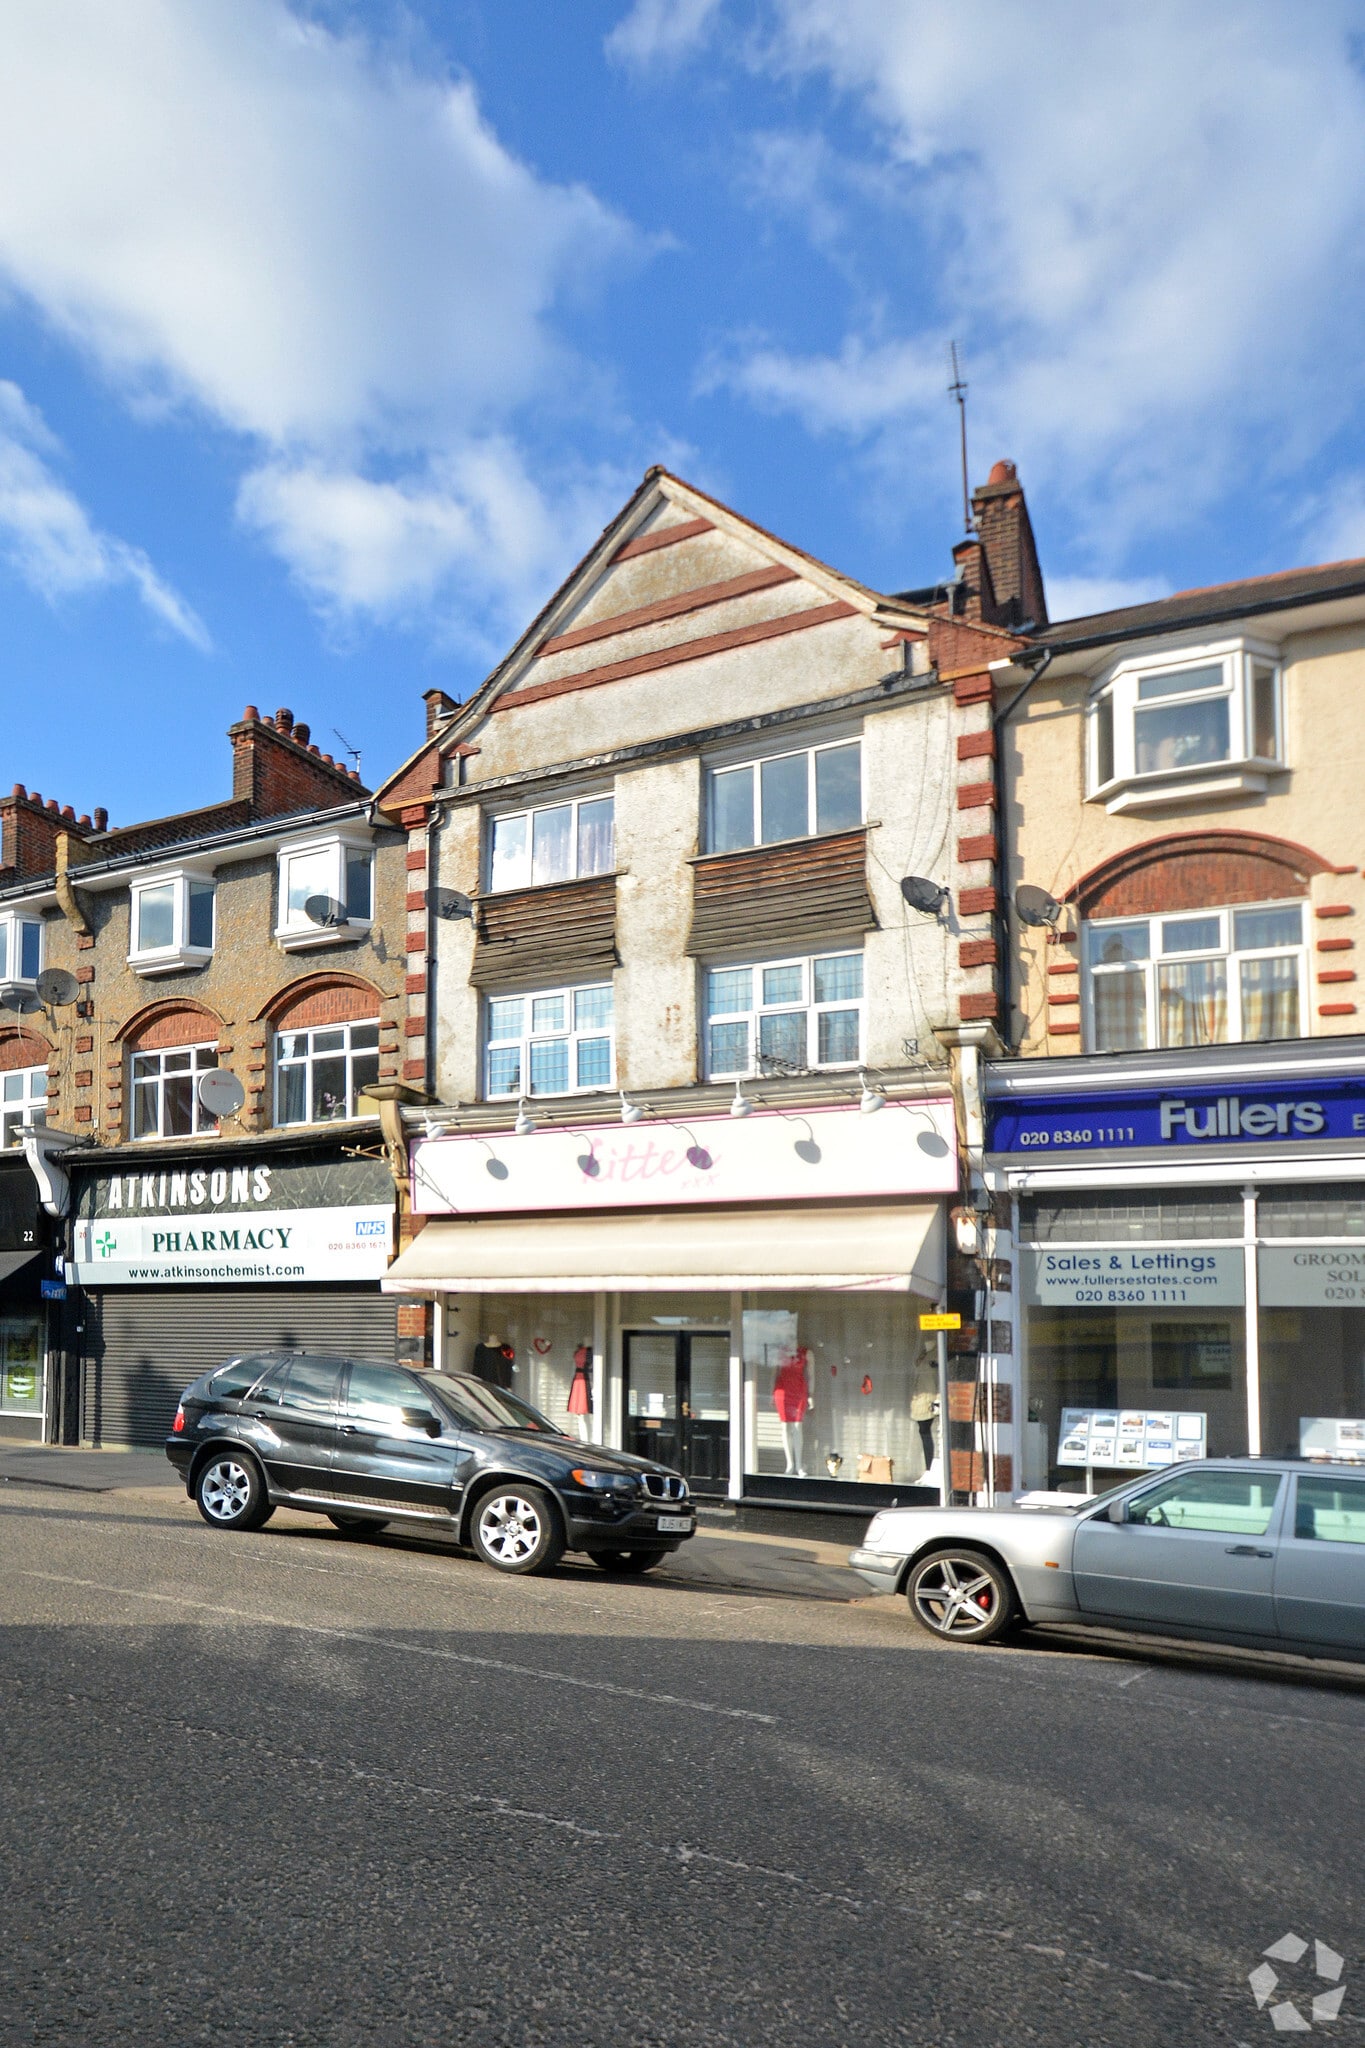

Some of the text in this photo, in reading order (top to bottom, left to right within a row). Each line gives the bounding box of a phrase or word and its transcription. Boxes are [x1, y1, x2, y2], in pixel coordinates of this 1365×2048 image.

[1159, 1097, 1326, 1139] Fullers
[1020, 1127, 1134, 1145] 020 8360 1111
[108, 1164, 272, 1209] ATKINSONS
[357, 1221, 385, 1235] NHS
[23, 1231, 34, 1242] 22
[152, 1227, 293, 1253] PHARMACY
[345, 1242, 366, 1250] 8360
[1046, 1253, 1217, 1272] Sales & Lettings
[128, 1264, 305, 1279] www.atkinsonchemist.com
[1045, 1274, 1218, 1287] www.fullersestates.com
[1075, 1289, 1187, 1302] 020 8360 1111
[1324, 1287, 1356, 1300] 020
